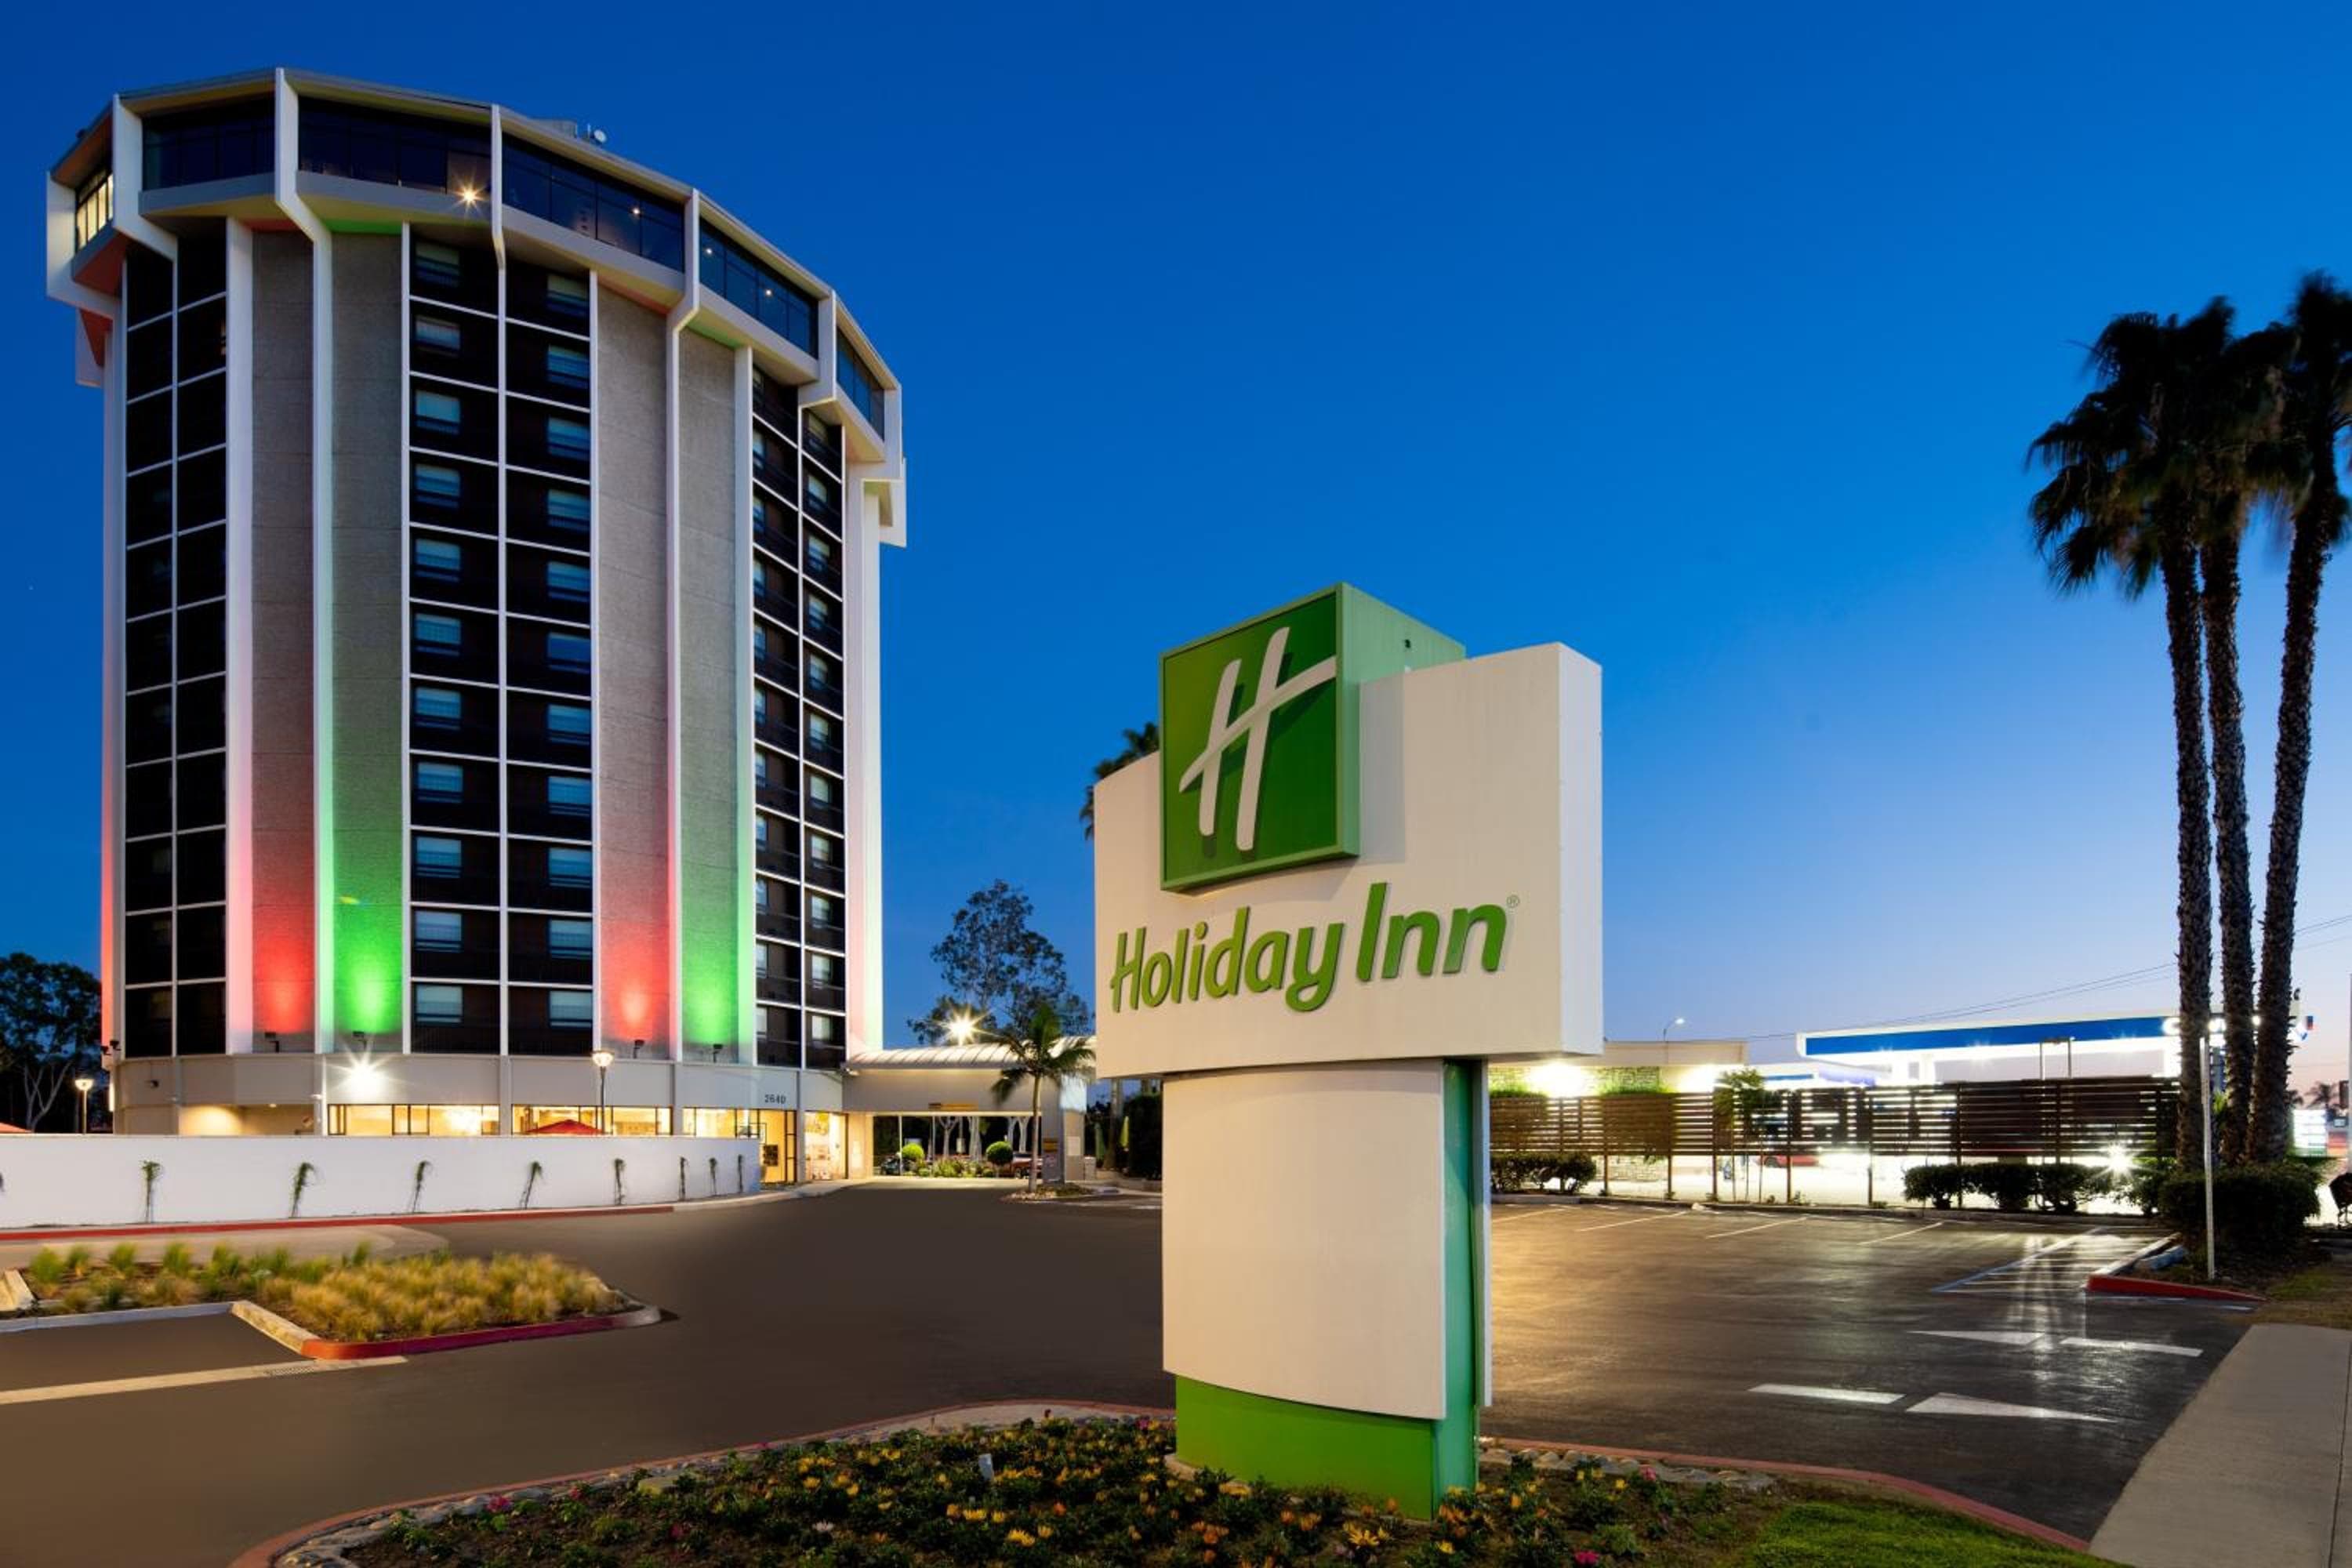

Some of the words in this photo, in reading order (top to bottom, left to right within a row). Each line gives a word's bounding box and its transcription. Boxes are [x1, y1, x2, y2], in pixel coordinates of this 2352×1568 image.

[1179, 626, 1337, 851] H
[1110, 906, 1344, 1012] Holiday
[1356, 882, 1507, 982] Inn
